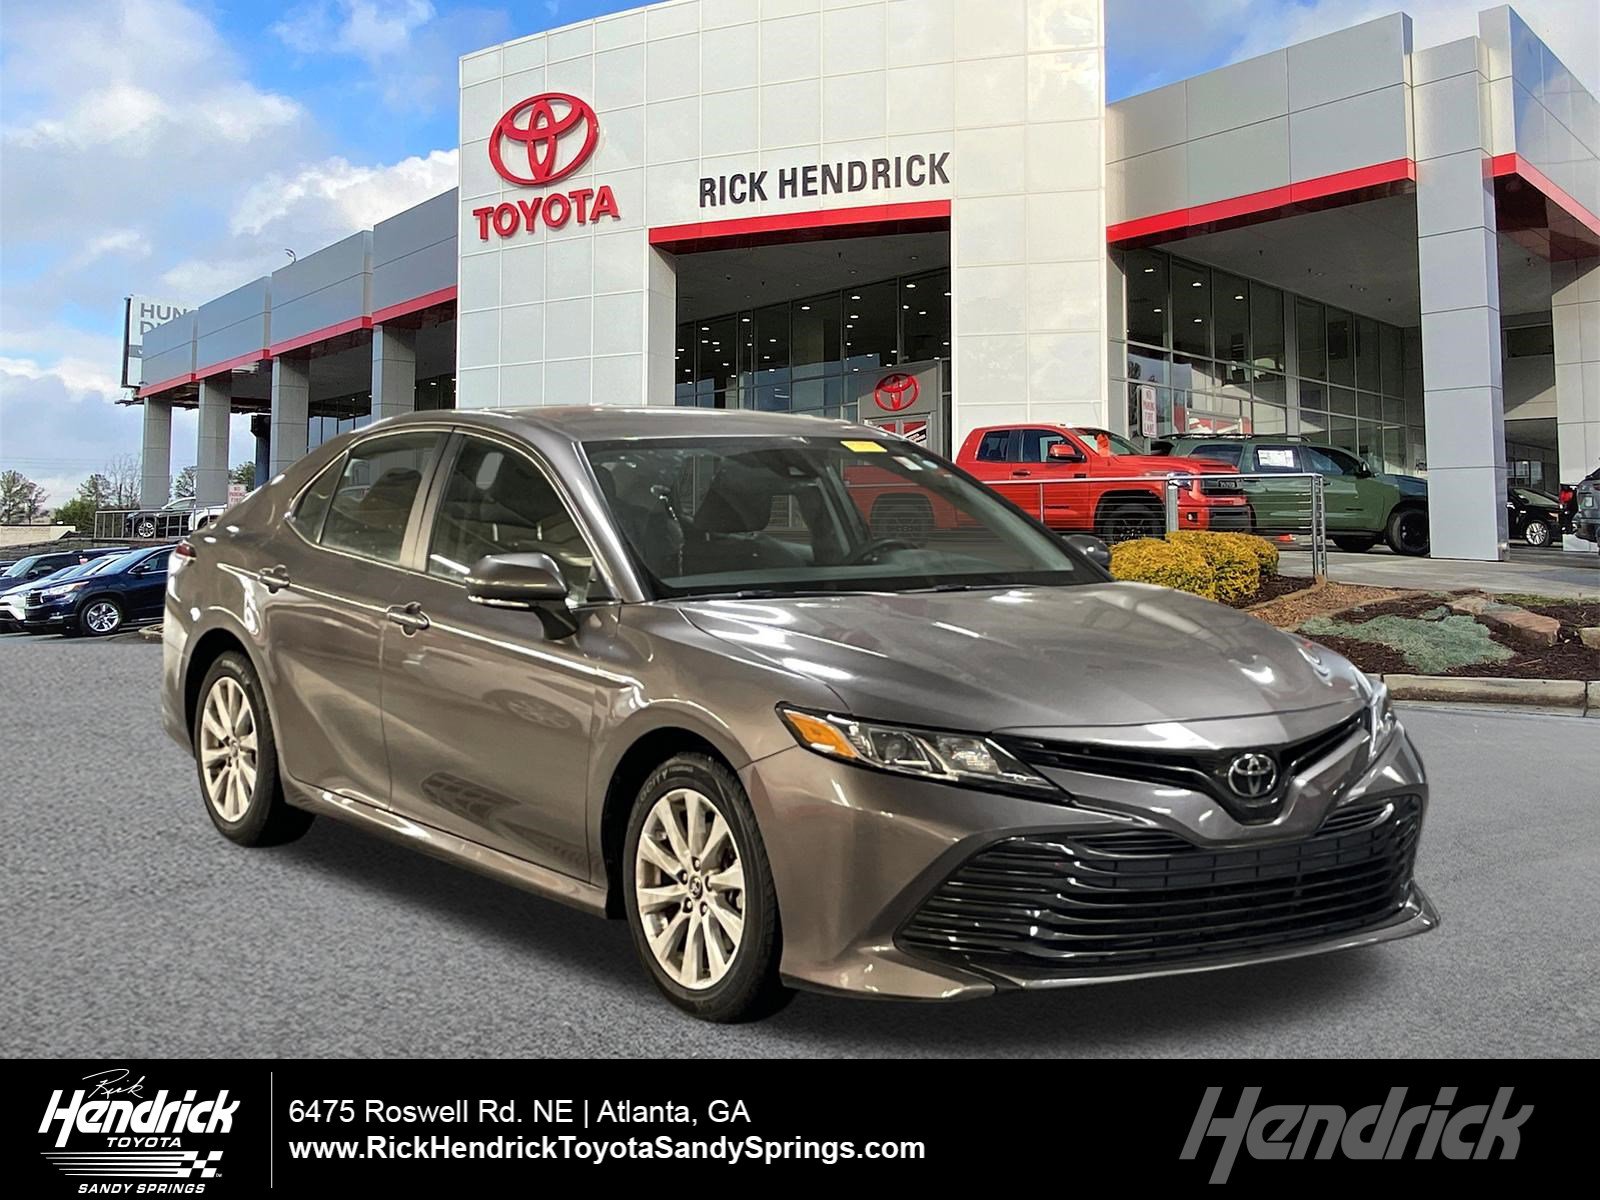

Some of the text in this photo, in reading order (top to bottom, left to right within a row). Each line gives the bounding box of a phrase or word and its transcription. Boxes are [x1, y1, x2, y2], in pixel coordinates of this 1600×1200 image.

[699, 152, 951, 208] RICK HENDRICK
[472, 185, 621, 242] TOYOTA
